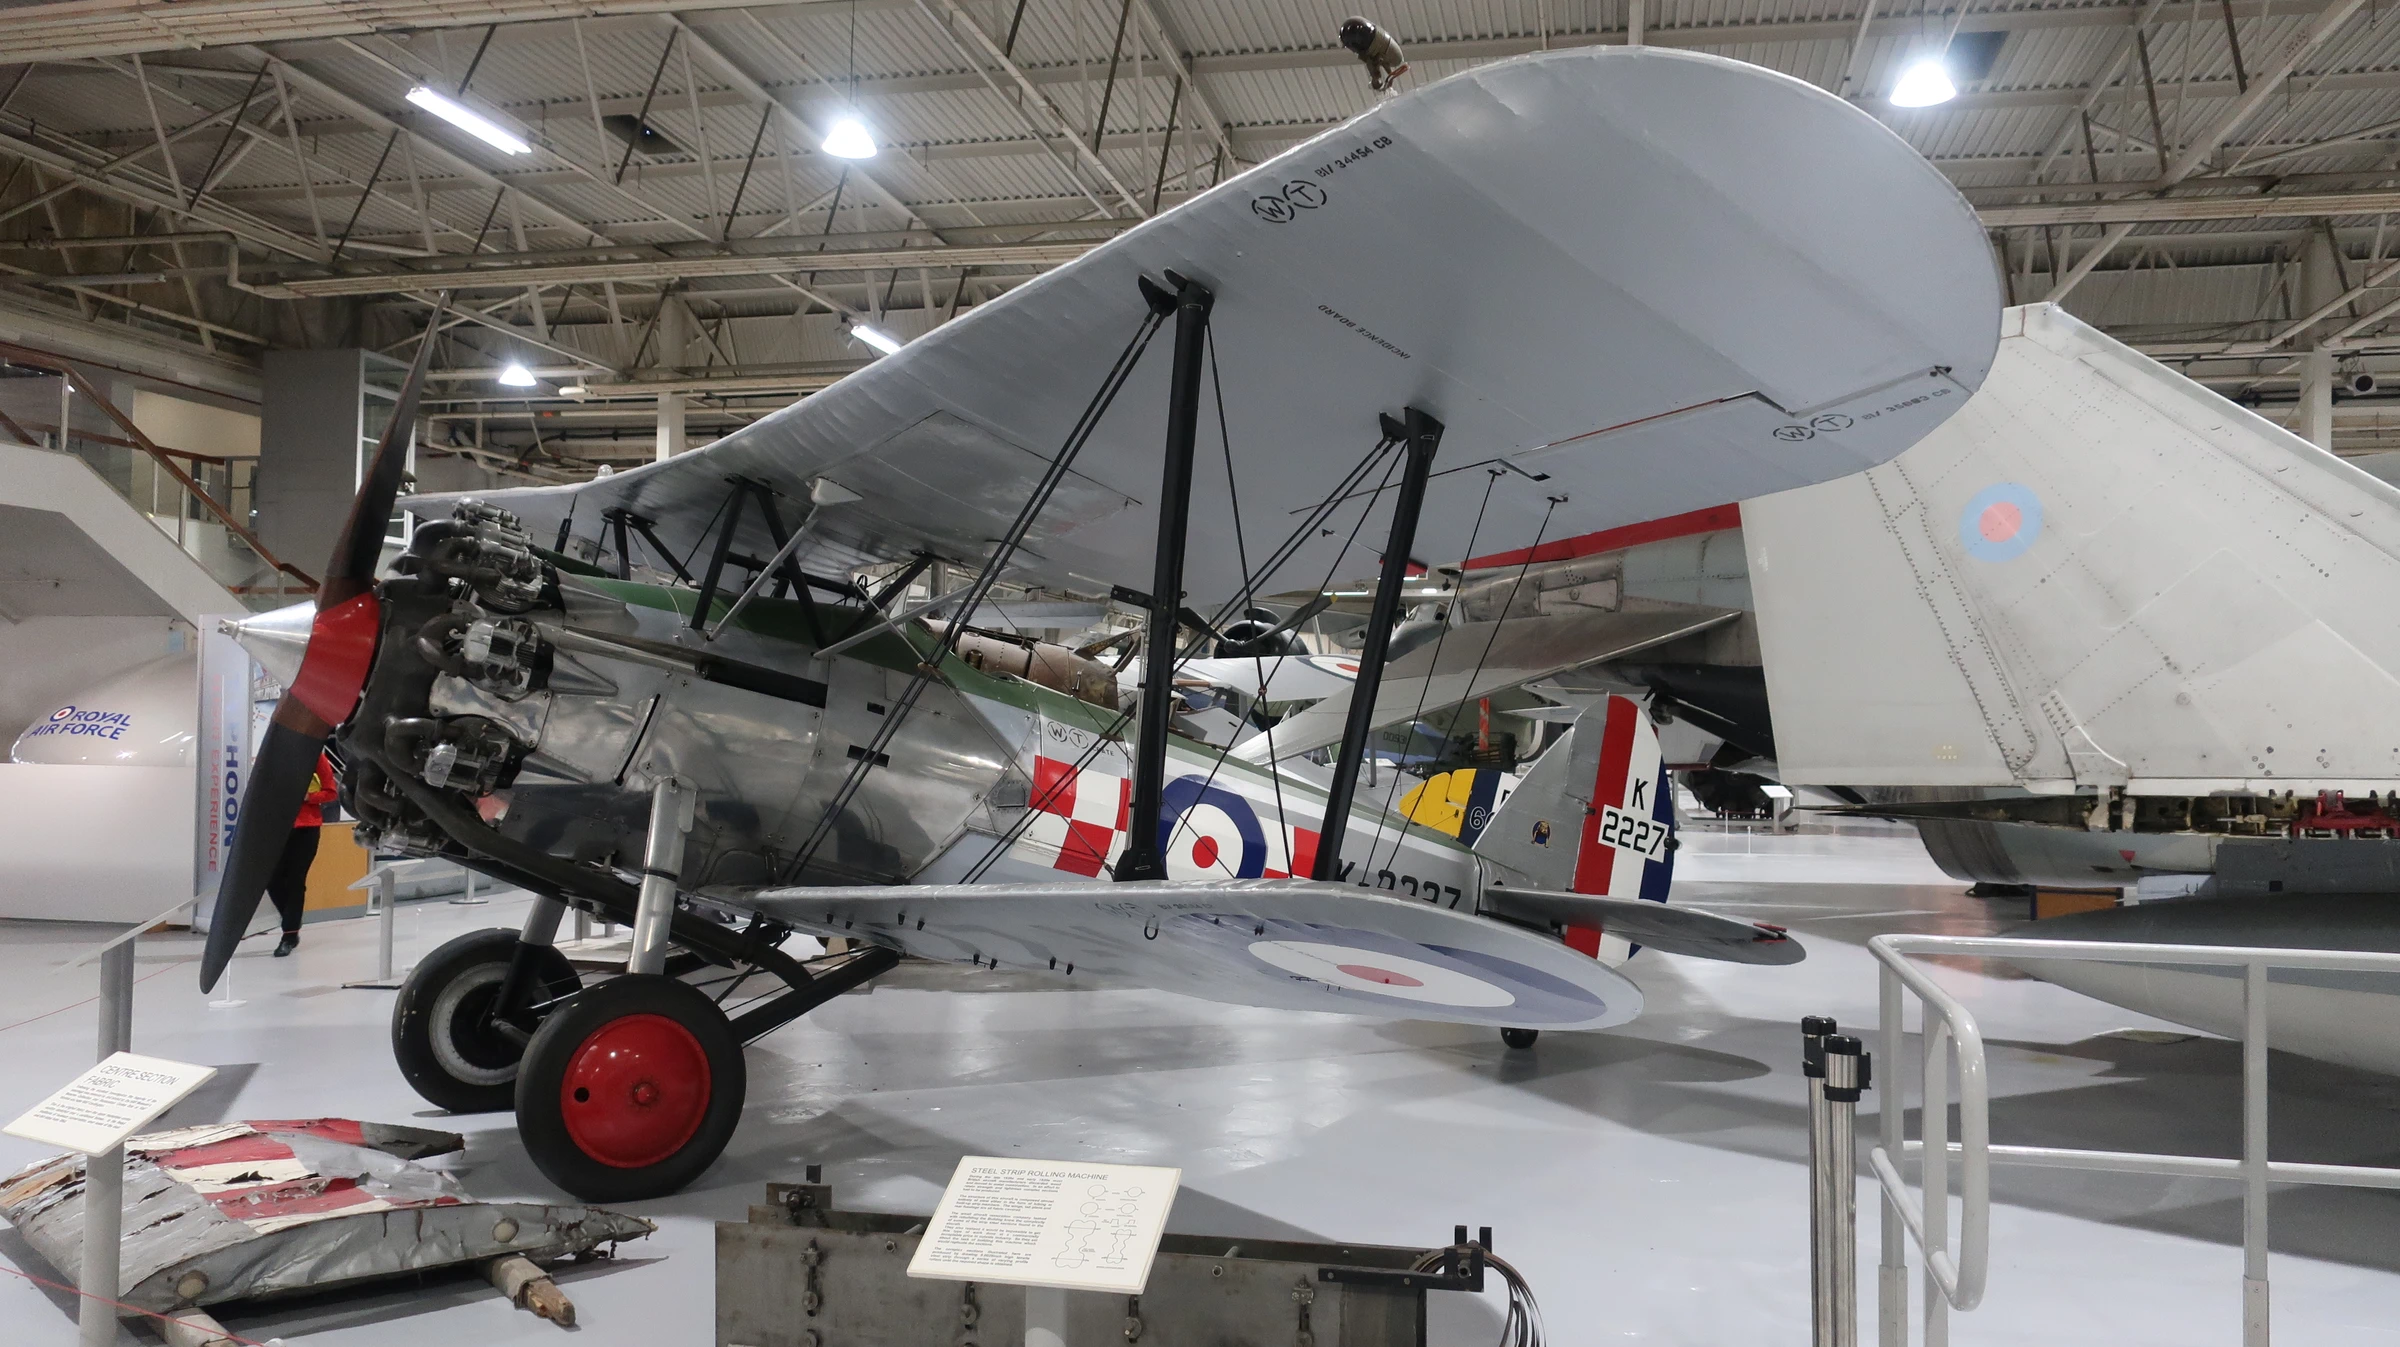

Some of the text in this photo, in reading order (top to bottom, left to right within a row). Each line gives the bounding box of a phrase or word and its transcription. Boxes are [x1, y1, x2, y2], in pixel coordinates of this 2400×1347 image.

[1334, 146, 1374, 168] 34454
[1372, 136, 1393, 149] CB
[1318, 304, 1411, 360] INCIDENCE BOARD
[27, 724, 127, 740] AIR FORCE
[72, 710, 132, 727] ROYAL
[224, 722, 239, 847] HOON
[1631, 777, 1648, 811] K
[208, 749, 220, 872] EXPERIENCE
[1602, 810, 1666, 856] 2227
[84, 1075, 121, 1089] FABRIC
[100, 1065, 181, 1086] CENTRE SECTION
[971, 1167, 998, 1175] STEEL
[1000, 1168, 1027, 1176] STRIP
[1027, 1169, 1067, 1178] ROLLING
[1067, 1173, 1109, 1181] MACHINE
